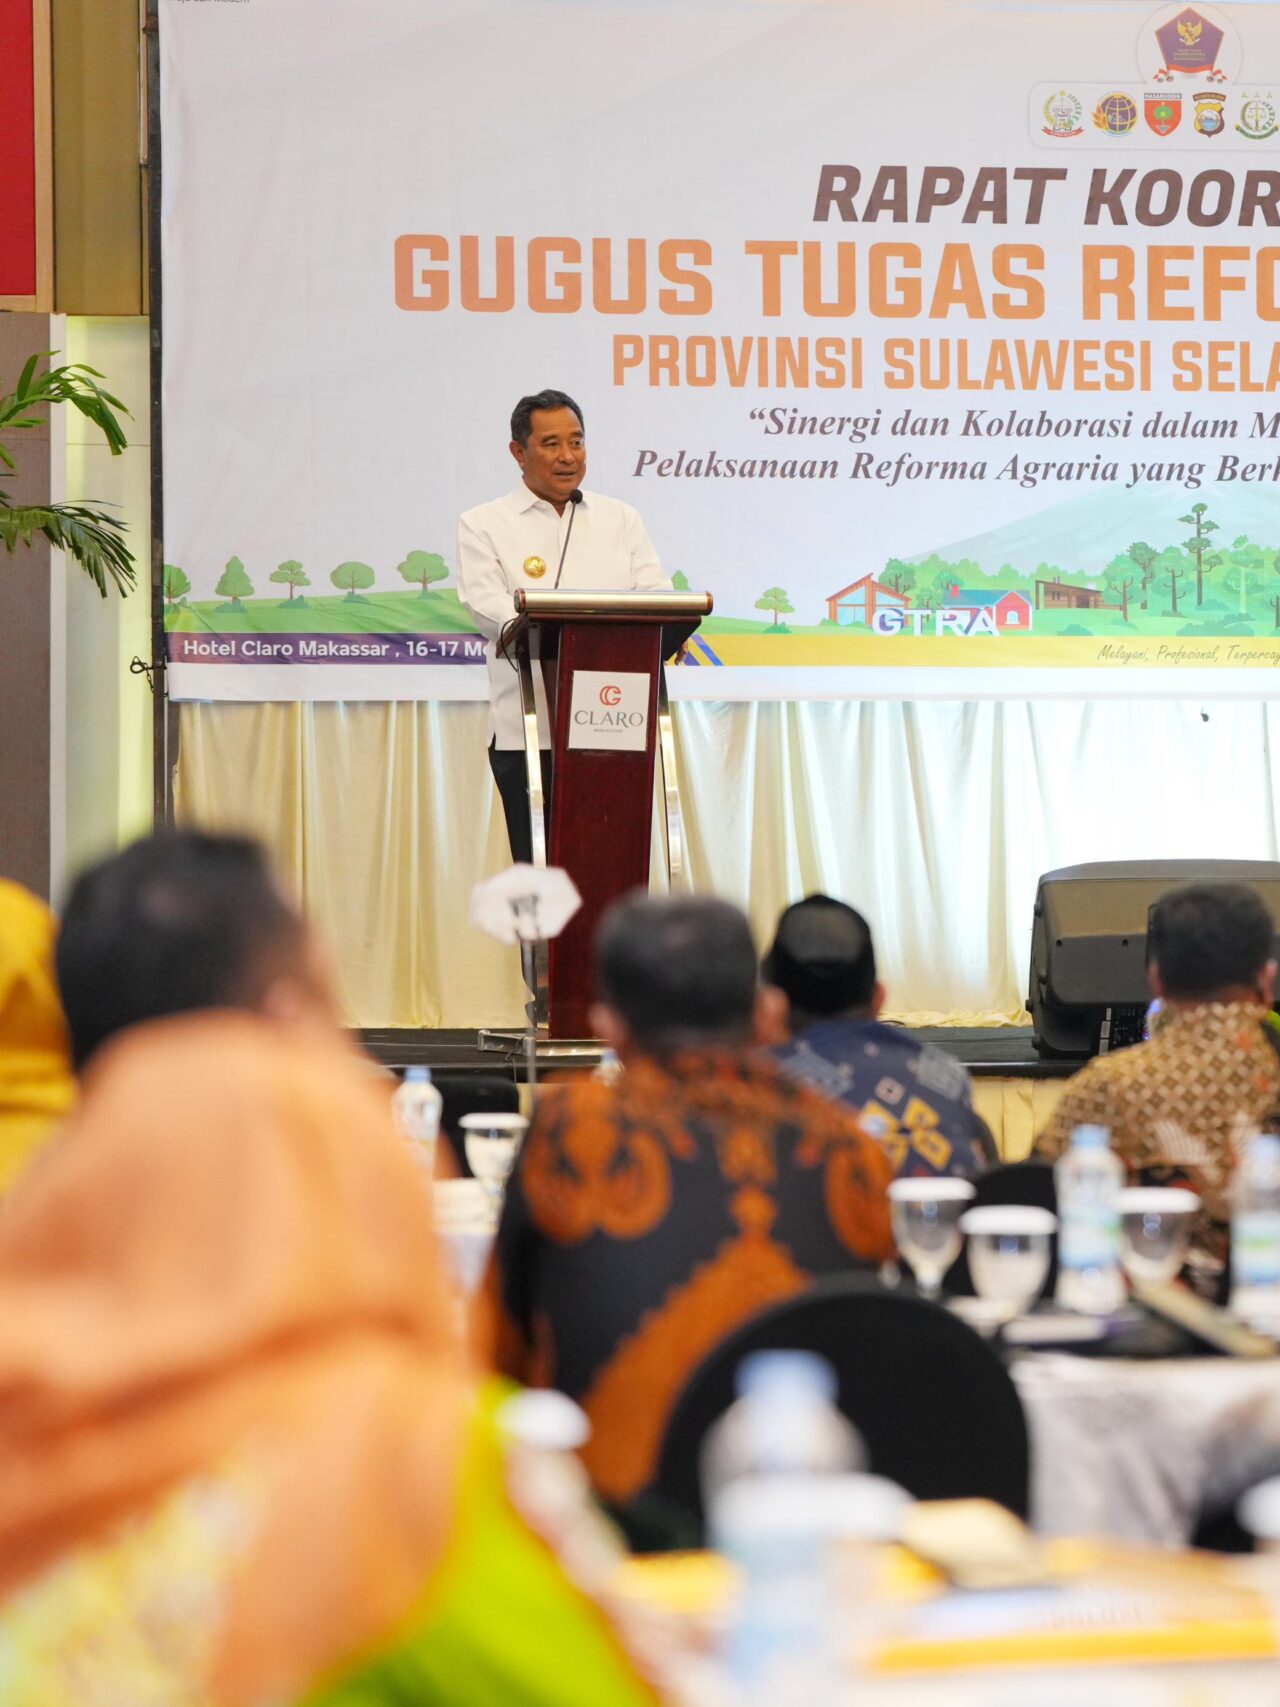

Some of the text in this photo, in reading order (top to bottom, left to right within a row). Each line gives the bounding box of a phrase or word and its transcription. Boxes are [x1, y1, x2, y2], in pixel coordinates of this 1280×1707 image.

[812, 164, 1069, 225] RAPAT
[394, 233, 714, 316] GUGUS
[744, 240, 1046, 321] TUGAS
[613, 334, 863, 390] PROVINSI
[884, 338, 1152, 393] SULAWESI
[749, 407, 882, 443] “Sinergi
[890, 409, 949, 436] dan
[960, 409, 1133, 438] Kolaborasi
[1142, 411, 1238, 438] dalam
[632, 449, 838, 479] Pelaksanaan
[850, 452, 987, 487] Reforma
[996, 454, 1119, 488] Agraria
[1125, 462, 1206, 489] yang
[872, 608, 1001, 637] GTRA
[183, 639, 236, 657] Hotel
[240, 640, 294, 657] Claro
[298, 640, 390, 658] Makassar
[405, 640, 459, 658] 16-17
[1097, 644, 1150, 664] Melayani,
[1156, 644, 1219, 664] Profesional,
[574, 710, 644, 729] CLARO
